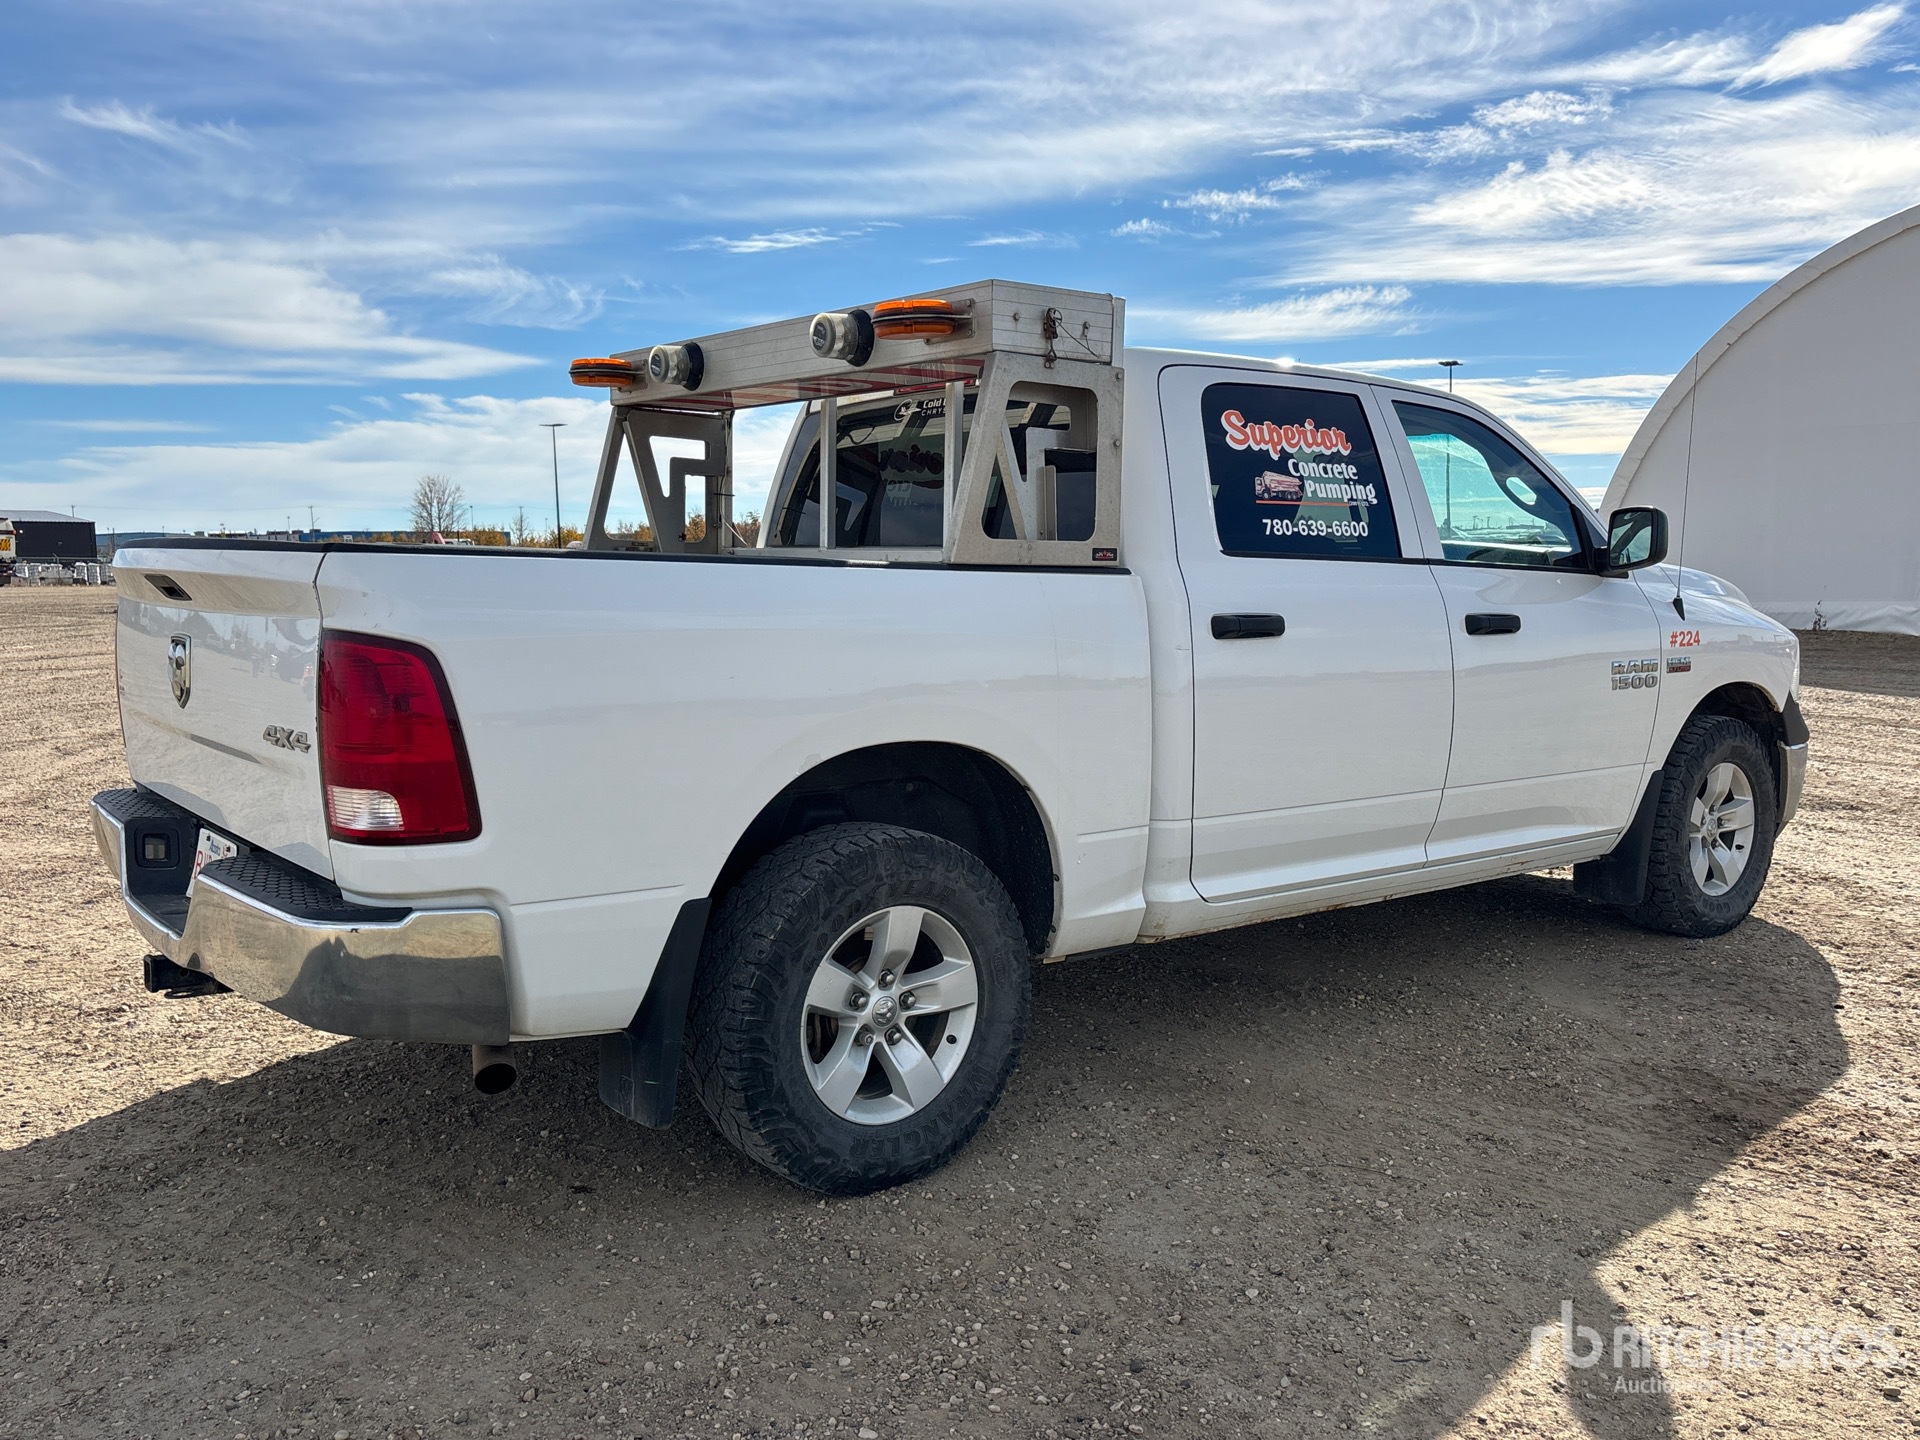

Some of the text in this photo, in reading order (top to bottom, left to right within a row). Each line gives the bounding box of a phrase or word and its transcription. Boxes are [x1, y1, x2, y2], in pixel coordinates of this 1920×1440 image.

[923, 399, 943, 412] Cold
[1221, 410, 1352, 460] Superior
[1288, 458, 1358, 479] Concrete
[1304, 480, 1377, 504] Pumping
[1262, 519, 1368, 537] 780-639-6600
[1670, 631, 1701, 648] #224
[1610, 658, 1659, 675] RAM
[1610, 673, 1659, 691] 1500
